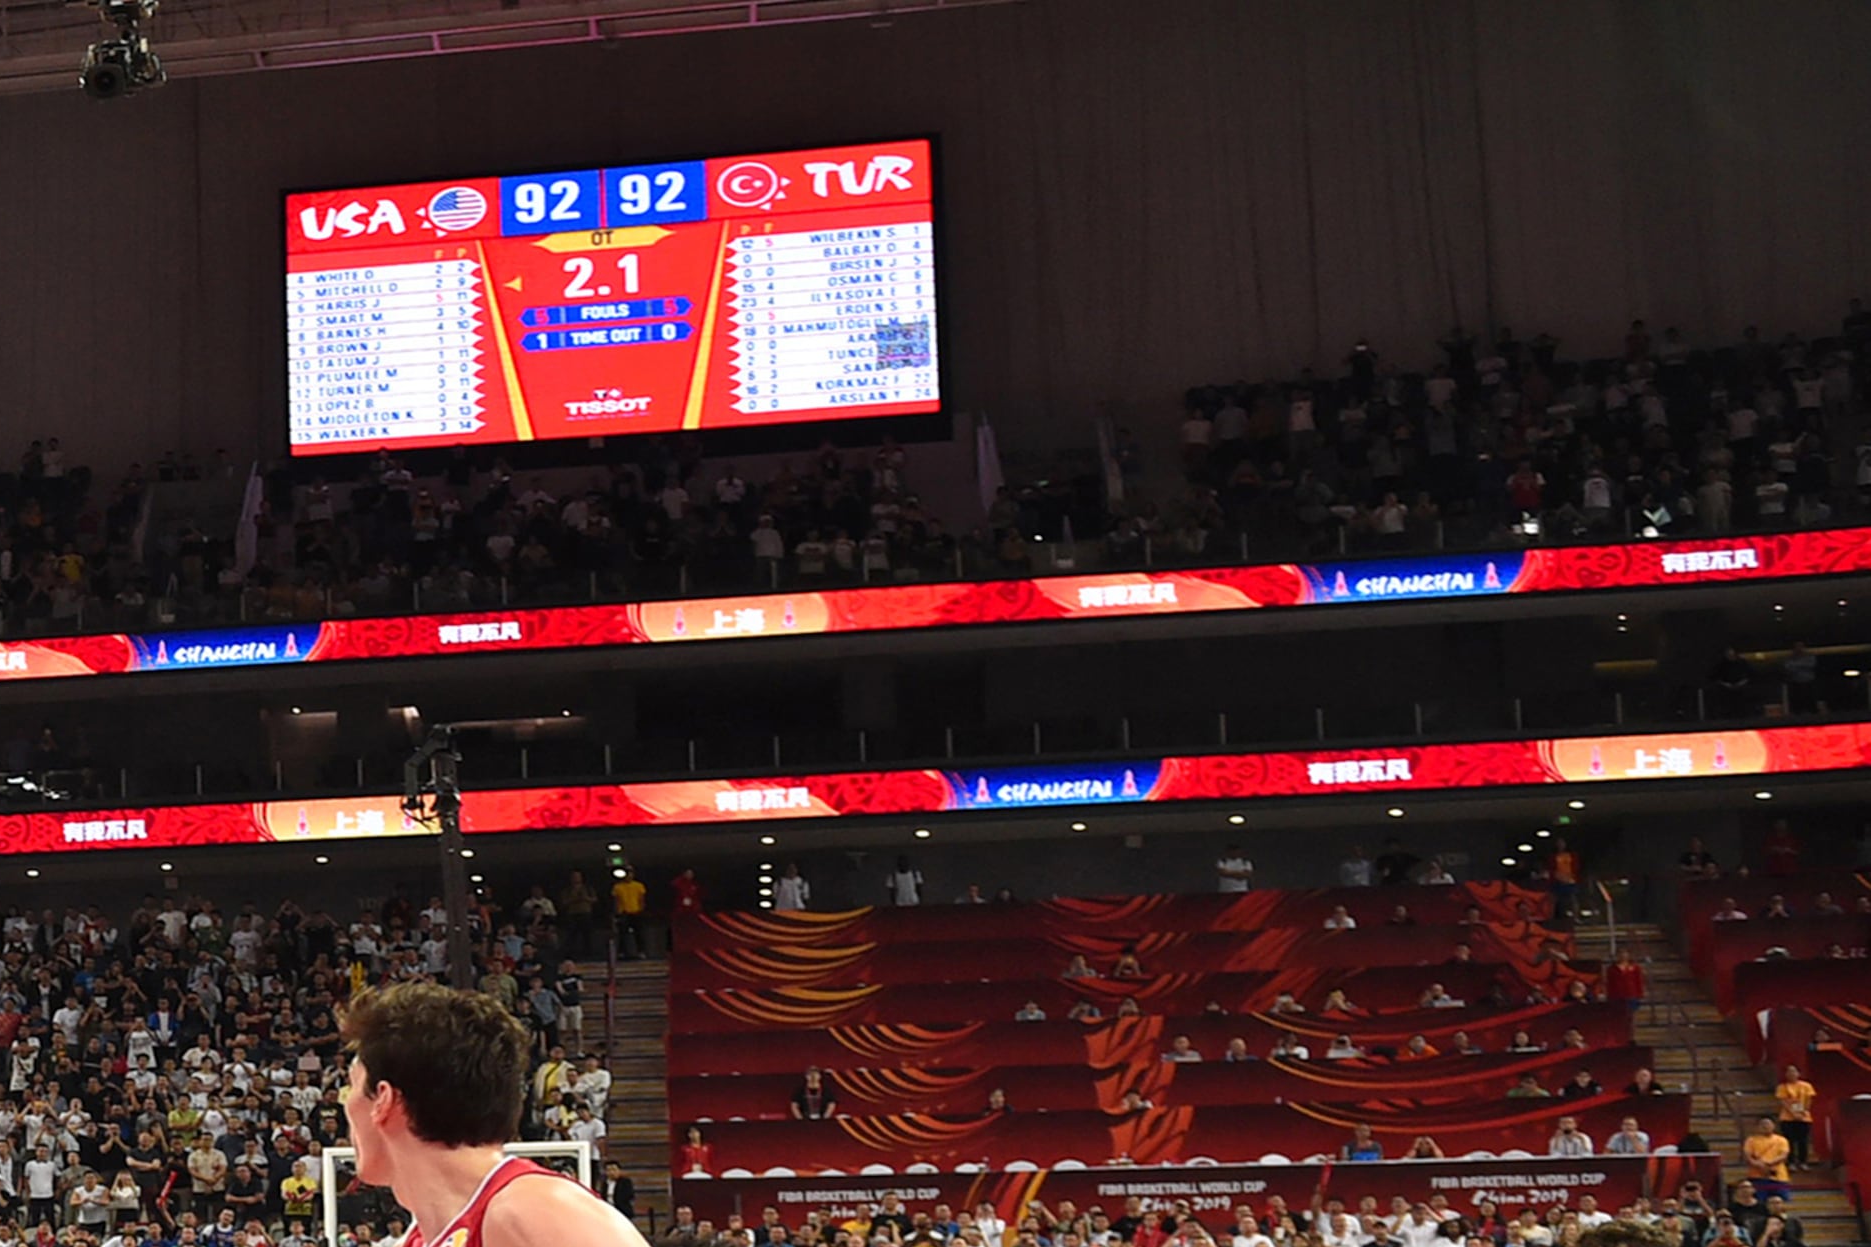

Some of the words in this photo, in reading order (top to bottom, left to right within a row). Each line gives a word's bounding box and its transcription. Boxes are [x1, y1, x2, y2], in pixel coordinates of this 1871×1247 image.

[805, 156, 914, 198] TUR
[514, 180, 581, 223] 92
[618, 171, 686, 214] 92
[300, 199, 405, 240] USA
[591, 231, 613, 246] OT
[563, 253, 640, 298] 2.1
[828, 274, 883, 287] OSMAN
[534, 308, 549, 324] 5
[581, 303, 630, 320] FOULS
[663, 298, 678, 315] 5
[536, 332, 548, 349] 1
[570, 330, 608, 345] TIME
[610, 326, 642, 342] OUT
[661, 323, 677, 340] 0
[563, 397, 652, 415] TISSOT
[1355, 572, 1474, 596] SHANGHAI
[706, 609, 766, 635] 上海
[174, 642, 277, 663] SHANGHAI
[1626, 747, 1693, 776] 上海
[997, 779, 1114, 802] SHANGHAI
[327, 809, 385, 835] 上海
[1098, 1183, 1126, 1195] FIBA
[1127, 1182, 1198, 1195] BASKETBALL
[1199, 1181, 1241, 1193] WORLD
[1243, 1180, 1267, 1192] CUP
[1431, 1176, 1459, 1189] FIBA
[1461, 1174, 1535, 1188] BASKETBALL
[1536, 1173, 1579, 1186] WORLD
[1580, 1172, 1606, 1185] CUP
[778, 1191, 803, 1202] FIBA
[805, 1189, 874, 1202] BASKETBALL
[875, 1188, 916, 1200] WLD
[917, 1187, 940, 1199] CUP
[1527, 1188, 1569, 1204] 2019
